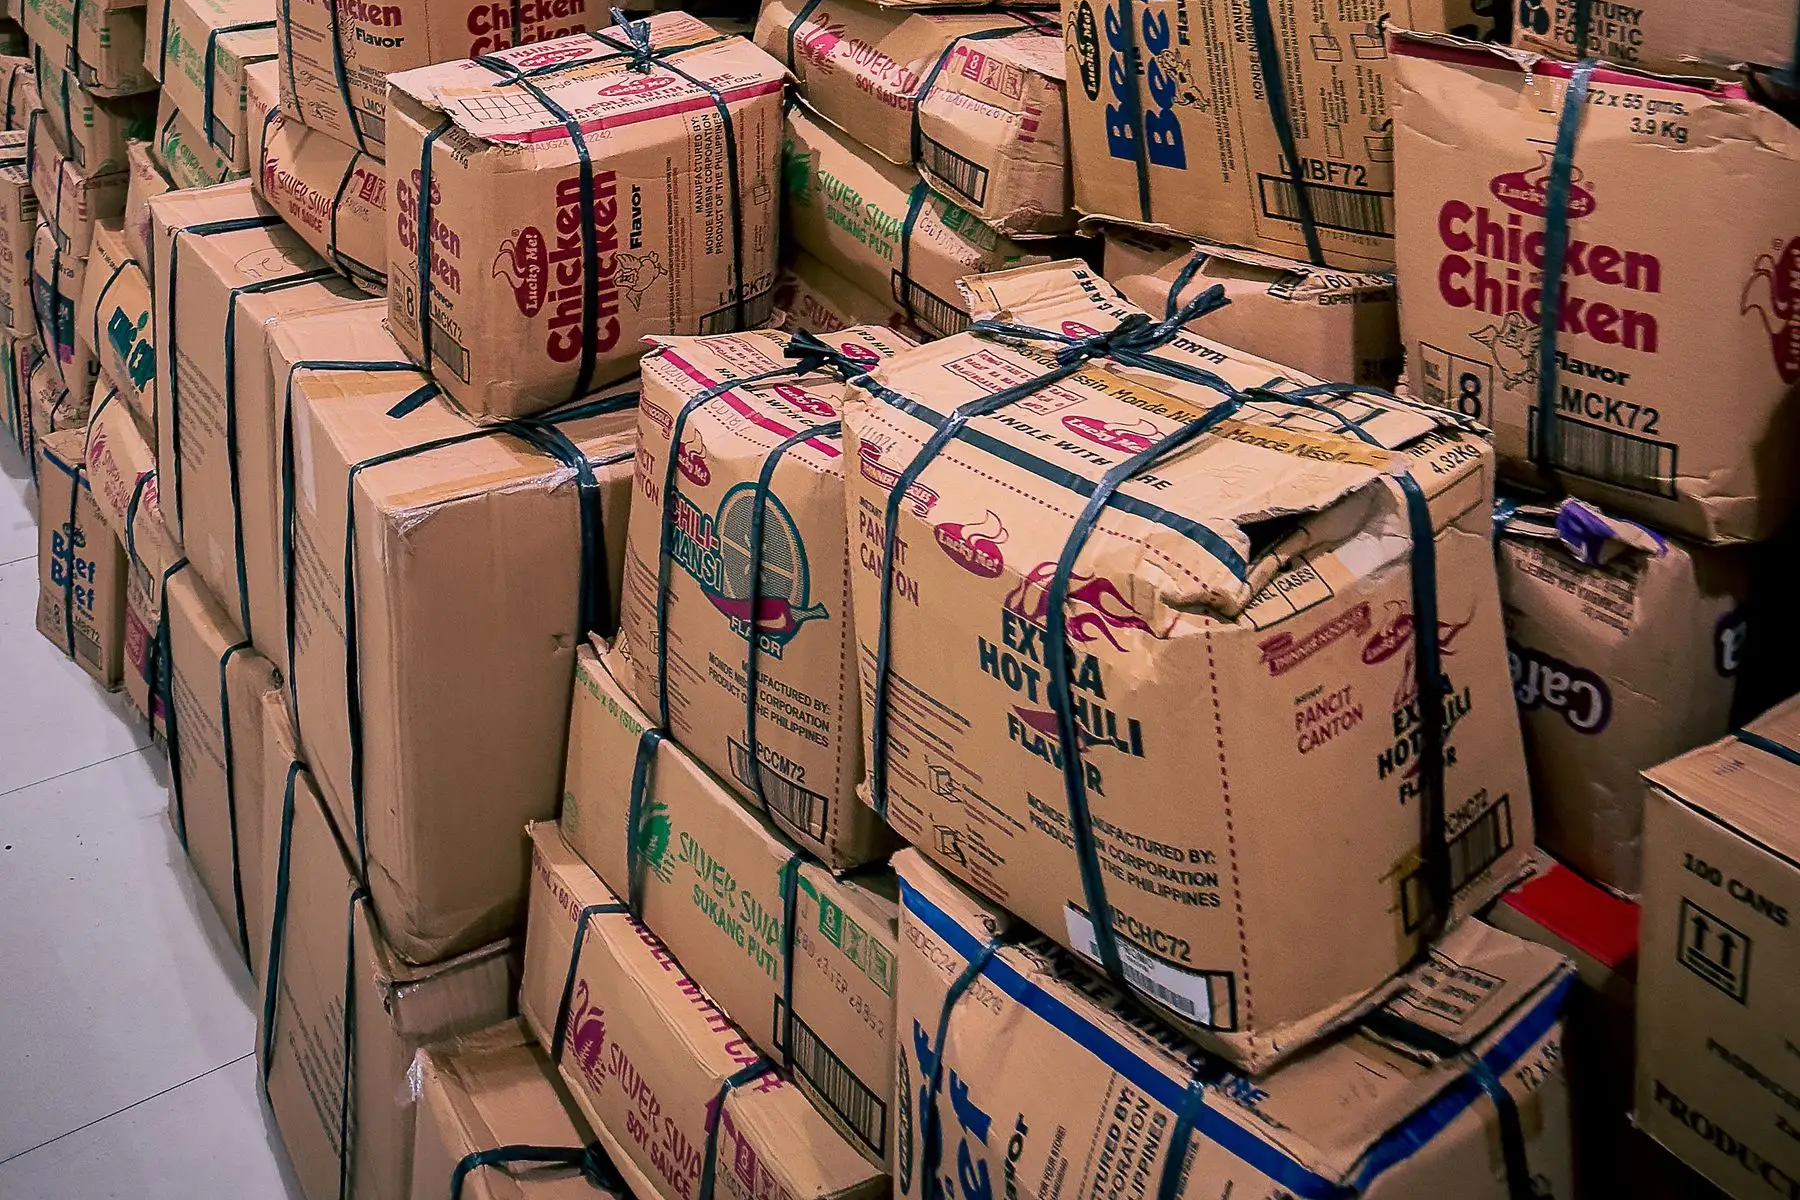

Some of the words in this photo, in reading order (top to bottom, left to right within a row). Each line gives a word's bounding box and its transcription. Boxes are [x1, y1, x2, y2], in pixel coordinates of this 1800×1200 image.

[355, 26, 405, 49] Flavor
[841, 38, 895, 82] SILVER
[970, 54, 979, 71] 8
[1084, 41, 1098, 95] Lucky
[1248, 56, 1264, 100] MONDE
[634, 85, 684, 100] WITH
[686, 80, 729, 96] MAKET
[733, 71, 763, 85] ONLY
[855, 73, 874, 95] SOY
[875, 83, 915, 112] SAUCE
[1587, 88, 1607, 106] 72
[1622, 92, 1643, 111] 55
[691, 115, 703, 132] BY:
[714, 112, 723, 173] PHILIPPINES
[1630, 117, 1656, 136] 3.9
[1660, 121, 1689, 143] Kg
[702, 114, 713, 186] CORPORATION
[691, 133, 703, 214] MANUFACTURED
[715, 174, 723, 194] THE
[396, 178, 461, 259] Chken
[629, 184, 643, 250] Flavor
[705, 188, 714, 220] NISSIN
[716, 196, 723, 212] OF
[397, 212, 462, 295] Chken
[525, 232, 539, 252] Me!
[706, 222, 714, 255] MONDE
[716, 213, 724, 255] PRODUCT
[525, 254, 539, 310] Lucky
[546, 176, 582, 363] Chicken
[406, 286, 415, 316] 8
[1170, 336, 1228, 364] HAND
[1017, 346, 1060, 370] onde
[1109, 388, 1168, 415] Monde
[1457, 371, 1483, 423] 8
[1066, 417, 1113, 442] Lucky
[1560, 384, 1660, 435] MCK72
[1056, 439, 1115, 467] WITH
[1430, 444, 1481, 475] 4.32Kg
[51, 530, 96, 585] Bef
[859, 510, 908, 564] PANIT
[50, 556, 95, 612] Bef
[1278, 567, 1316, 593] CASES
[730, 615, 783, 660] FLAOR
[708, 651, 735, 683] MONDE
[759, 688, 830, 732] CORPORATION
[977, 634, 1041, 705] HOT
[818, 694, 832, 712] BY:
[1295, 686, 1353, 731] PANCIT
[770, 710, 829, 748] PHILIPPINES
[1297, 704, 1364, 755] CANTON
[742, 730, 806, 783] LPCCM72
[1007, 712, 1107, 799] FLAVR
[1107, 845, 1219, 888] CORPORATION
[1188, 848, 1218, 865] BY:
[678, 831, 736, 908] SILVER
[739, 889, 783, 947] SWA
[1126, 870, 1221, 909] PHILIPPINES
[1683, 852, 1723, 888] 100
[1726, 877, 1790, 928] CANS
[692, 883, 744, 949] SUKANG
[747, 937, 778, 981] PUTI
[608, 1043, 661, 1133] SILVER
[663, 1118, 701, 1183] SWA
[1112, 1087, 1135, 1123] BY:
[626, 1109, 649, 1151] SOY
[651, 1148, 692, 1200] SAUCE
